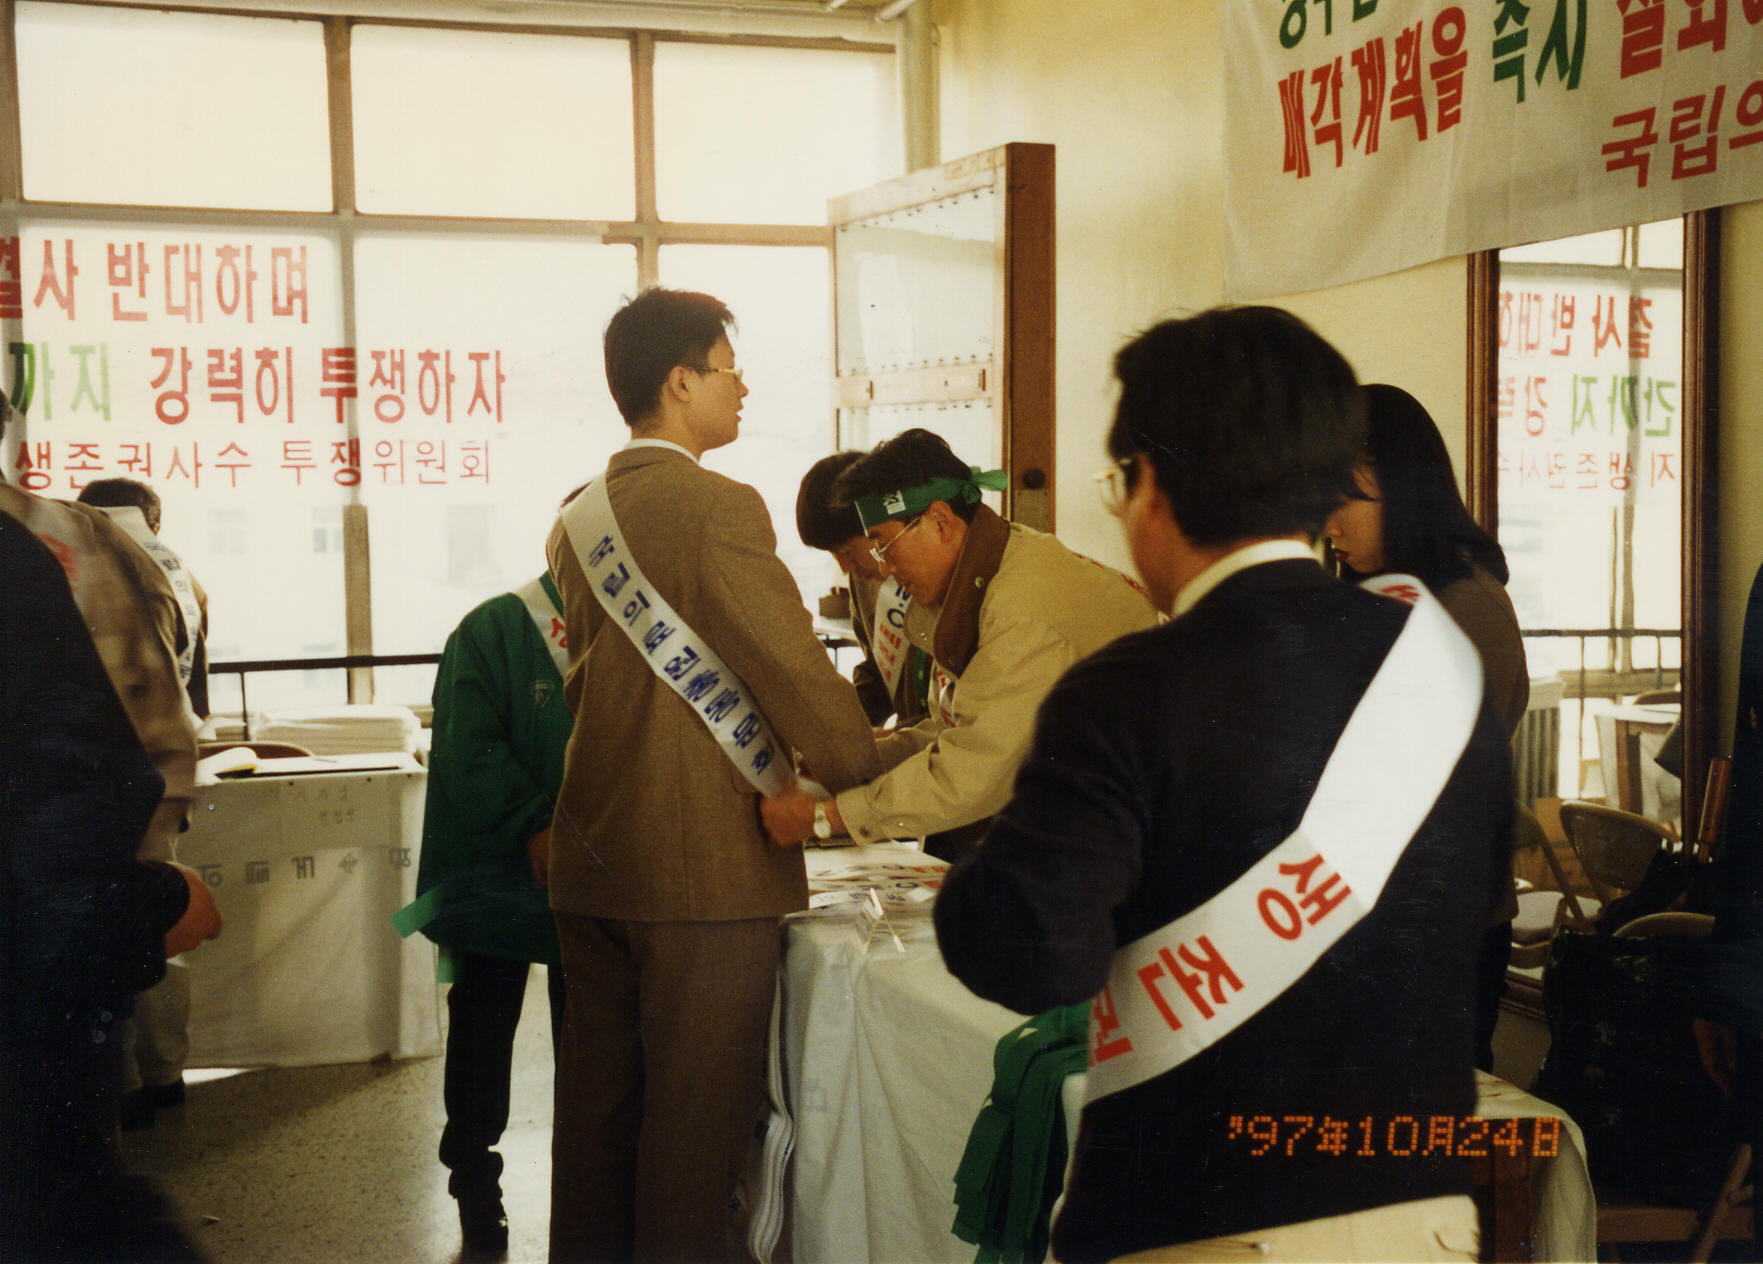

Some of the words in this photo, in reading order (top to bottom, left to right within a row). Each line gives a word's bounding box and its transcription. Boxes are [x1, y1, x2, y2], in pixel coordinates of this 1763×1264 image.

[1278, 6, 1468, 179] 매각계획을
[107, 242, 309, 324] 반대하며
[150, 346, 294, 425] 강력히
[320, 346, 507, 424] 투쟁하자
[14, 440, 252, 491] 생존권사수
[280, 437, 489, 489] 투쟁위원회
